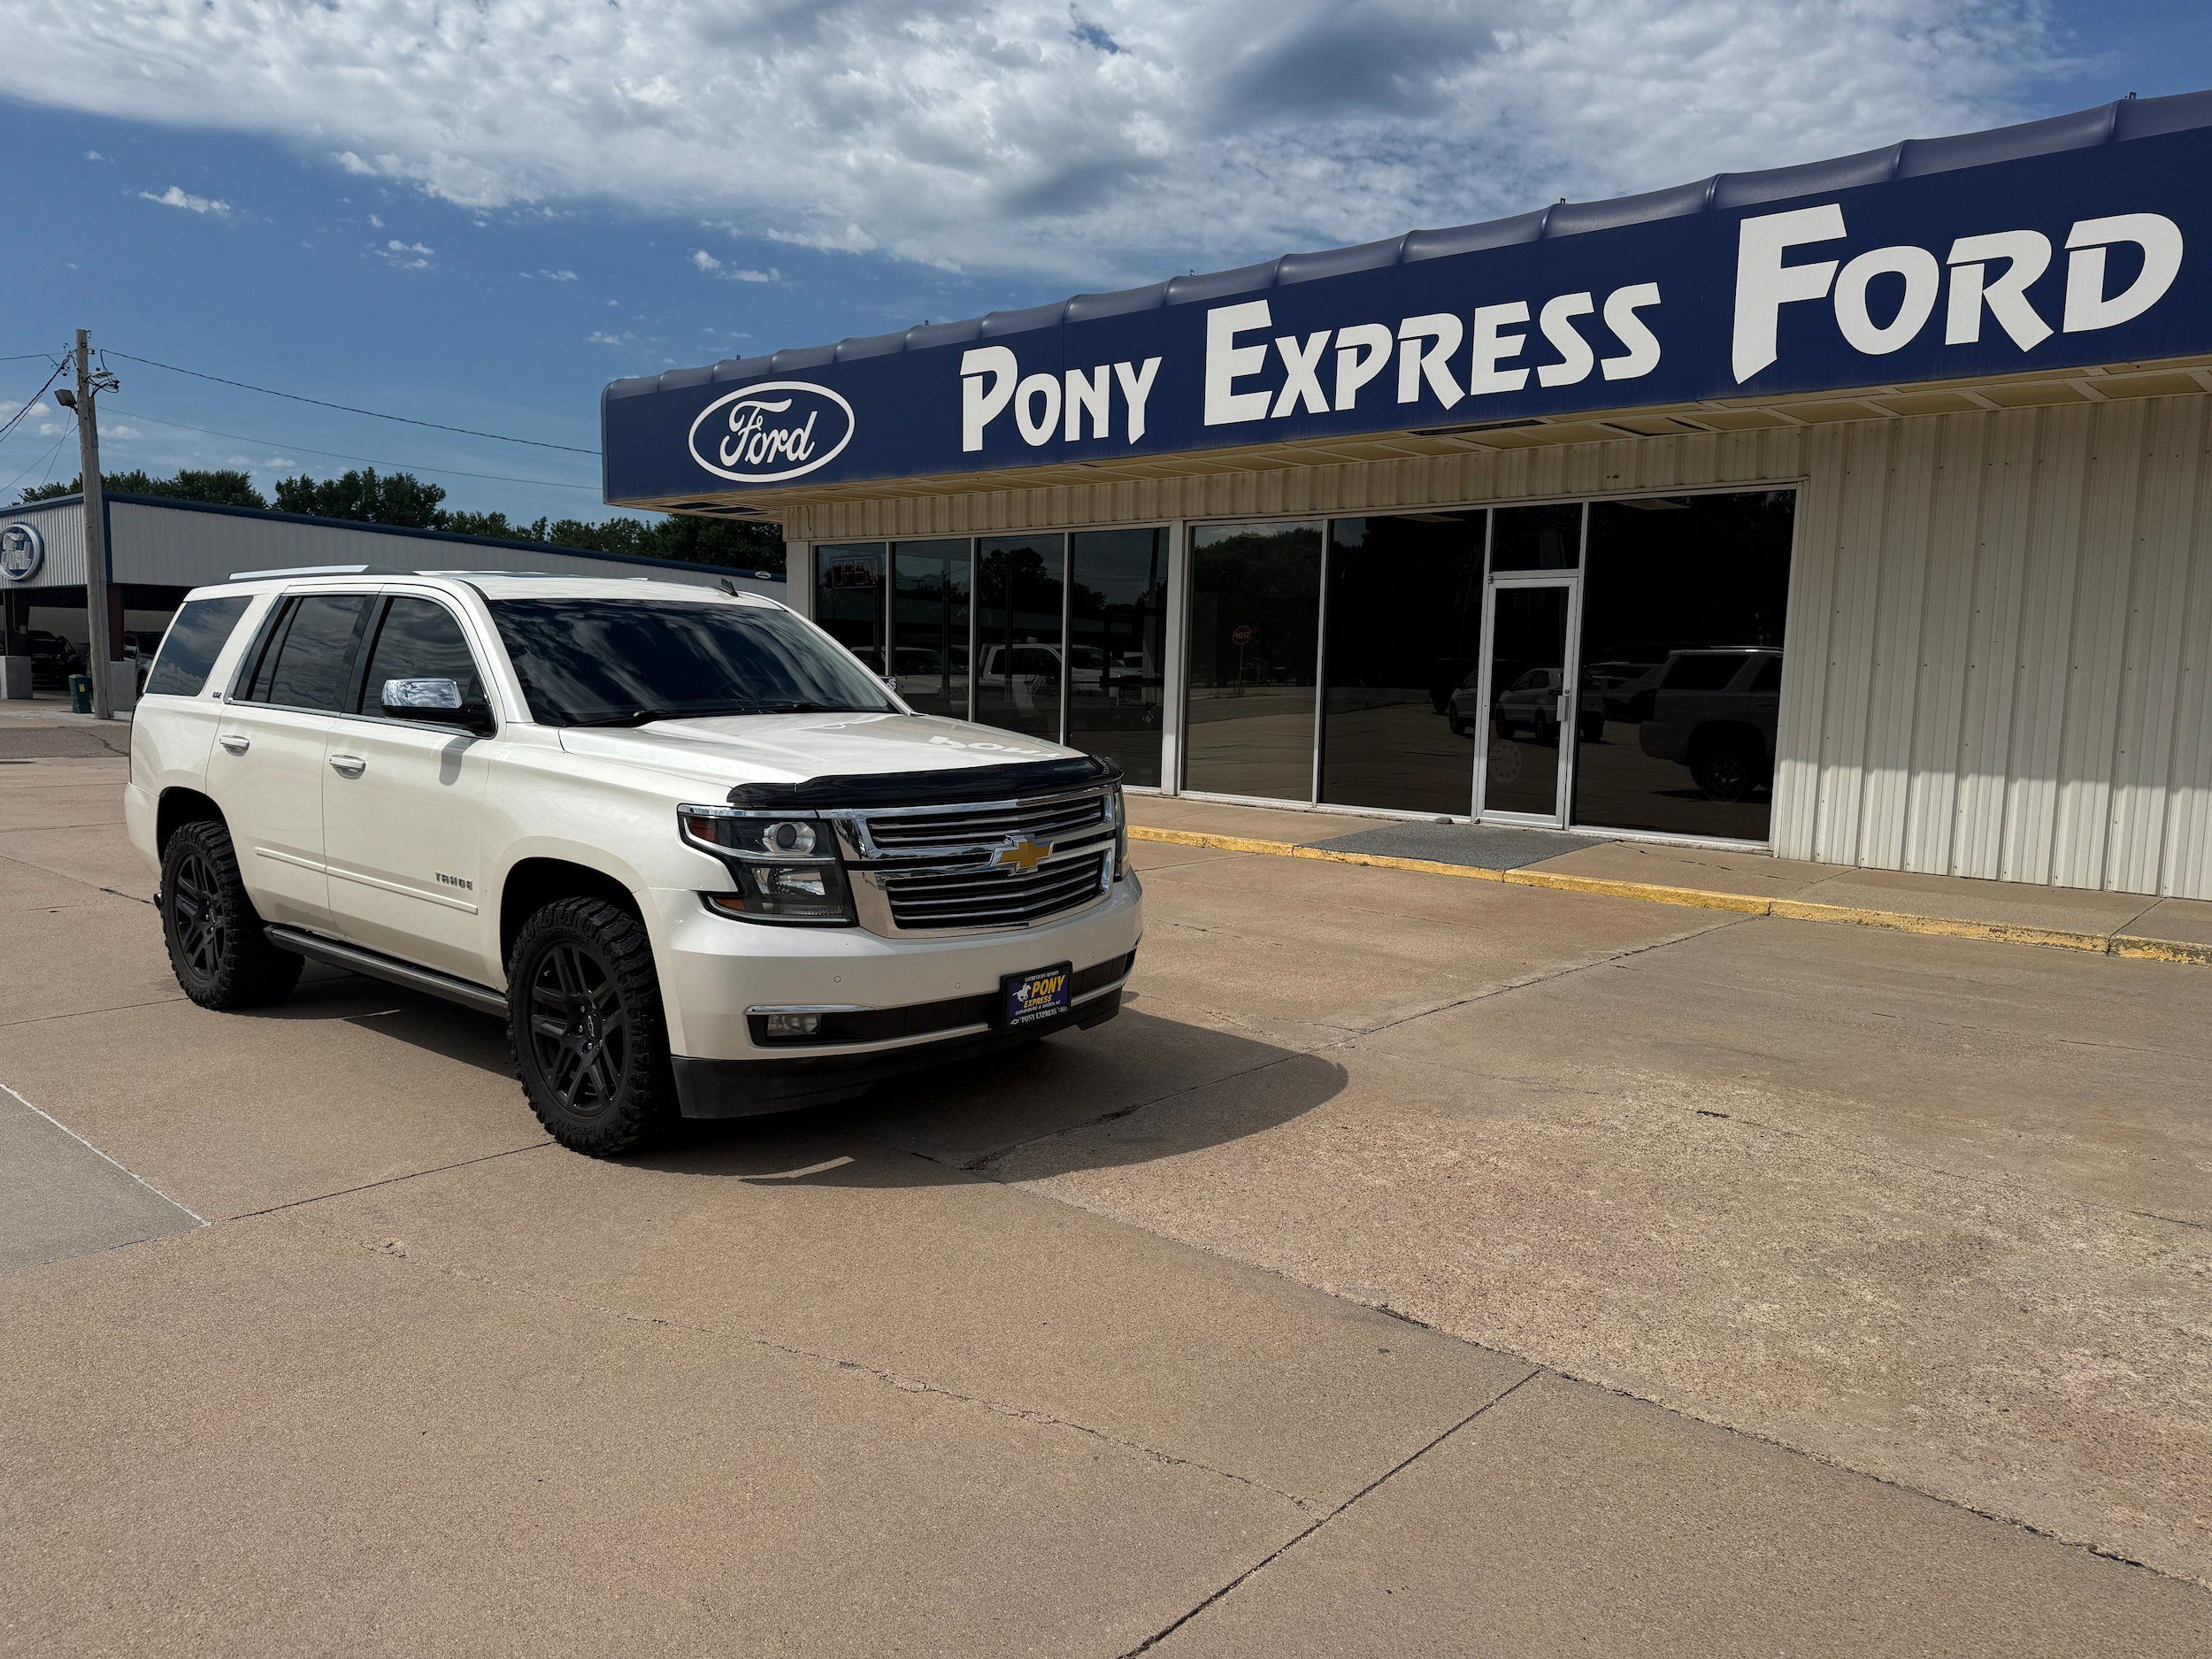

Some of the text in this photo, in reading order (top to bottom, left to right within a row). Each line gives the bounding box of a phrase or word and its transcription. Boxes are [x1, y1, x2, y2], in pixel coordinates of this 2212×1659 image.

[960, 204, 2184, 452] PONY EXPRESS FORD
[719, 398, 818, 466] Ford
[434, 872, 473, 891] TAHOE
[1032, 975, 1065, 997] PONY
[1024, 995, 1052, 1008] EXPRESS
